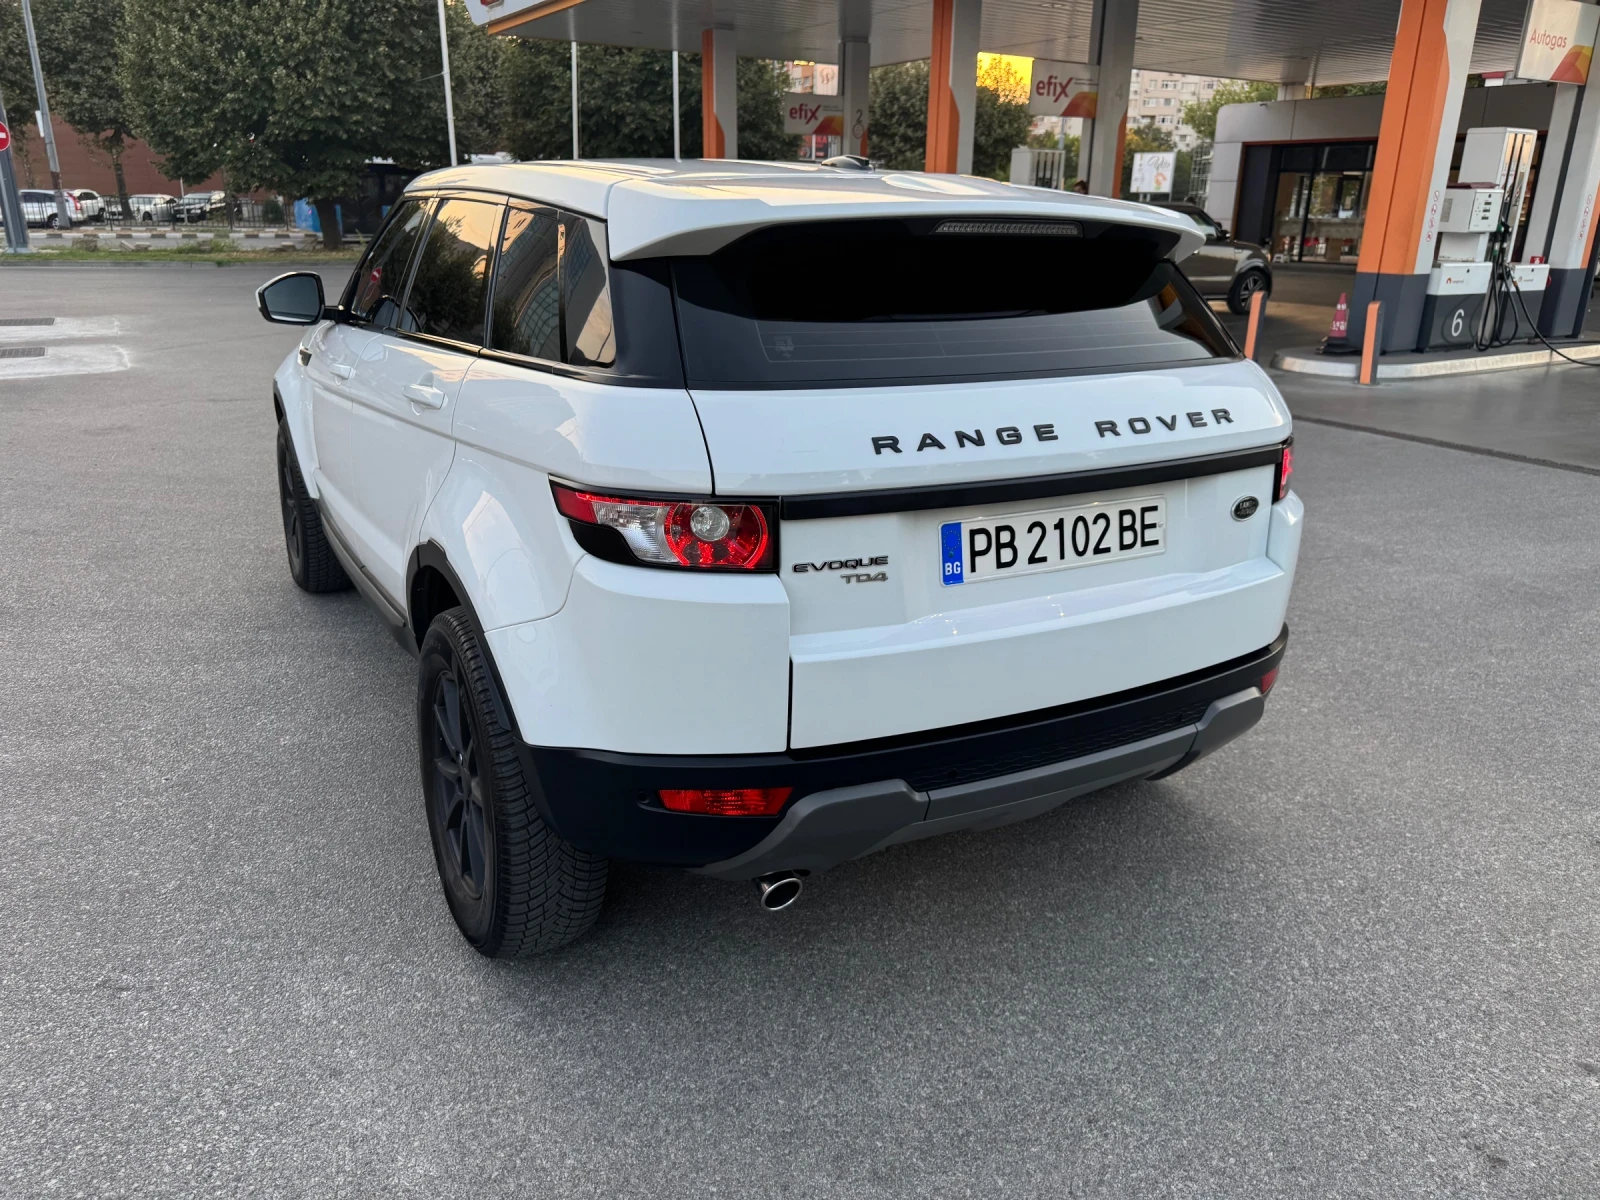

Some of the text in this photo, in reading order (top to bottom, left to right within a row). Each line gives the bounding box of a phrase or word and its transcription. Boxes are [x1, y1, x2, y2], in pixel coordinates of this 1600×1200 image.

[1529, 28, 1568, 50] Autogas
[1035, 75, 1074, 103] efix
[789, 103, 822, 125] efix
[855, 109, 864, 123] 2
[1451, 308, 1465, 337] 6
[871, 408, 1234, 455] RANGE ROVER
[969, 505, 1160, 573] PB 2102 BE
[792, 555, 889, 573] EVOQUE
[944, 561, 962, 576] BG
[840, 571, 889, 584] TD4
